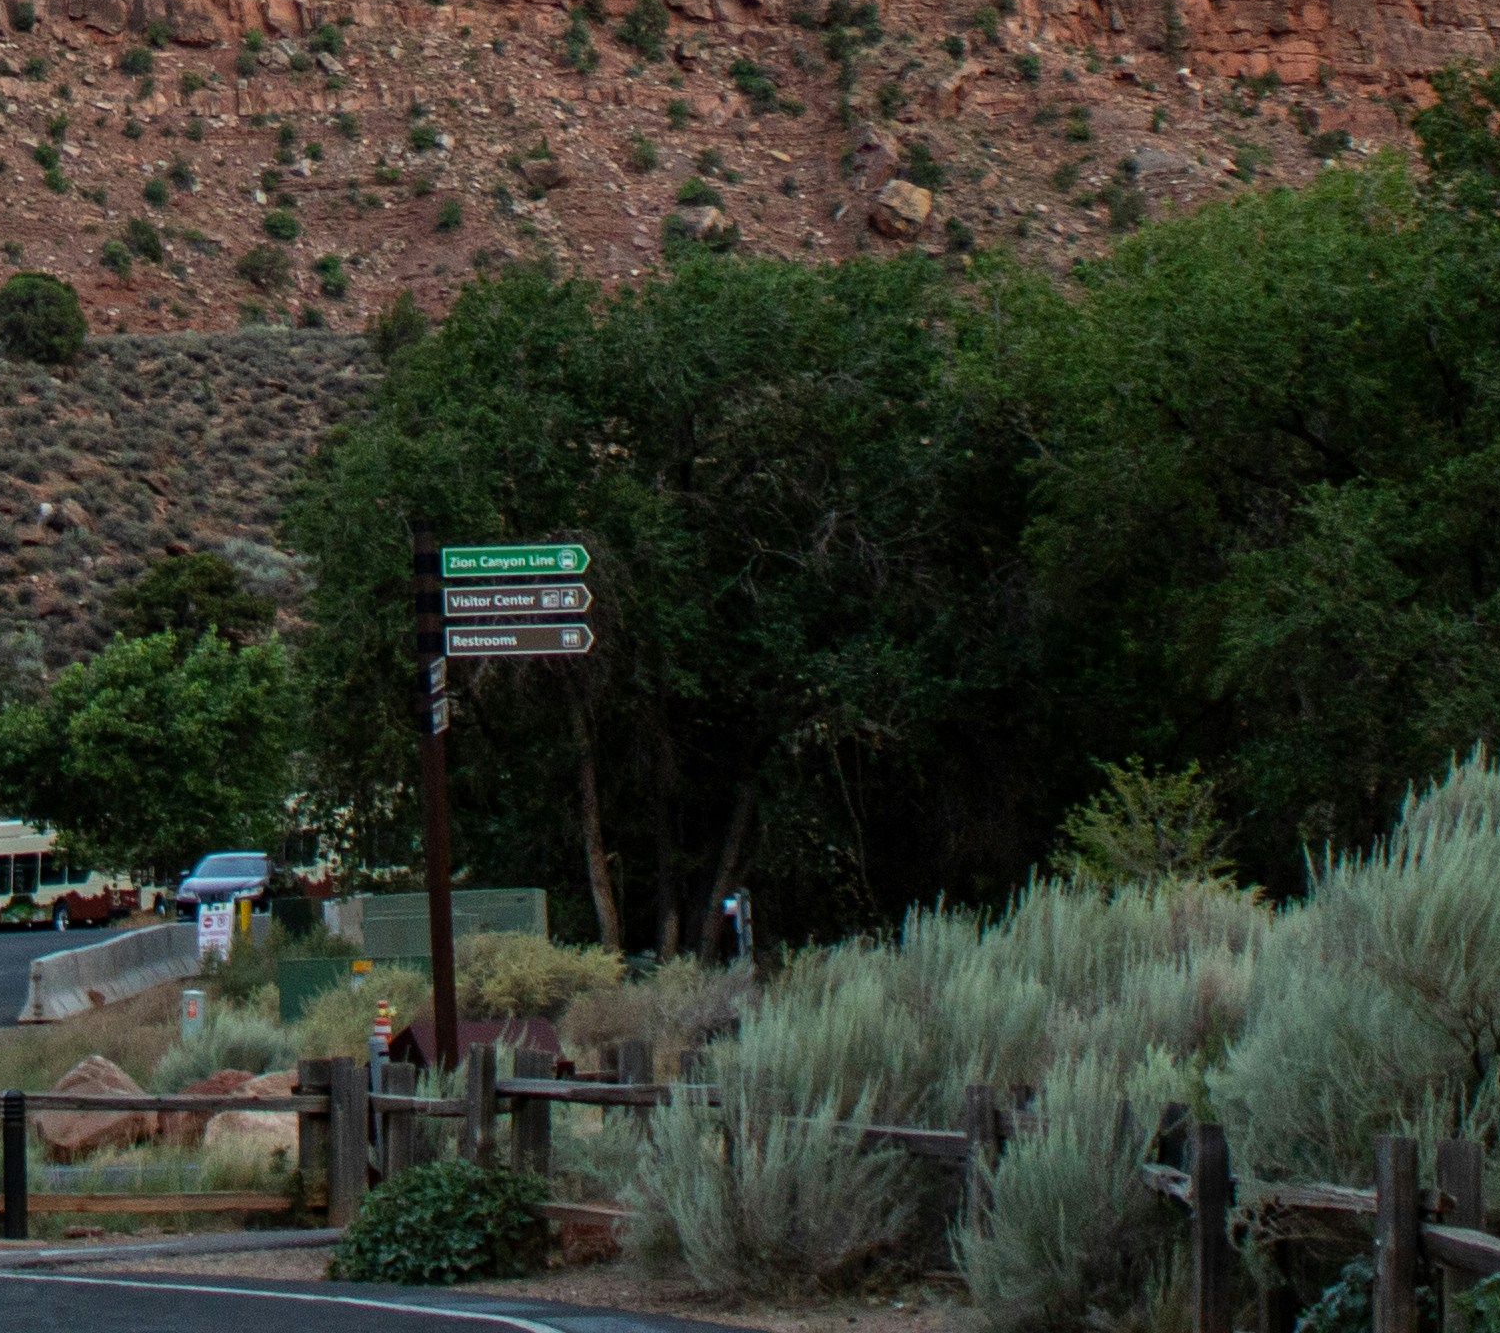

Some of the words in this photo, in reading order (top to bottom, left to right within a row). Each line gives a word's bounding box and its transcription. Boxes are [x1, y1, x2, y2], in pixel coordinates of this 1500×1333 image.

[449, 556, 477, 569] Zion
[480, 555, 526, 570] Canyon
[528, 554, 556, 567] Line
[450, 595, 492, 608] Visitor
[494, 594, 536, 607] Center
[452, 635, 518, 647] Restrooms
